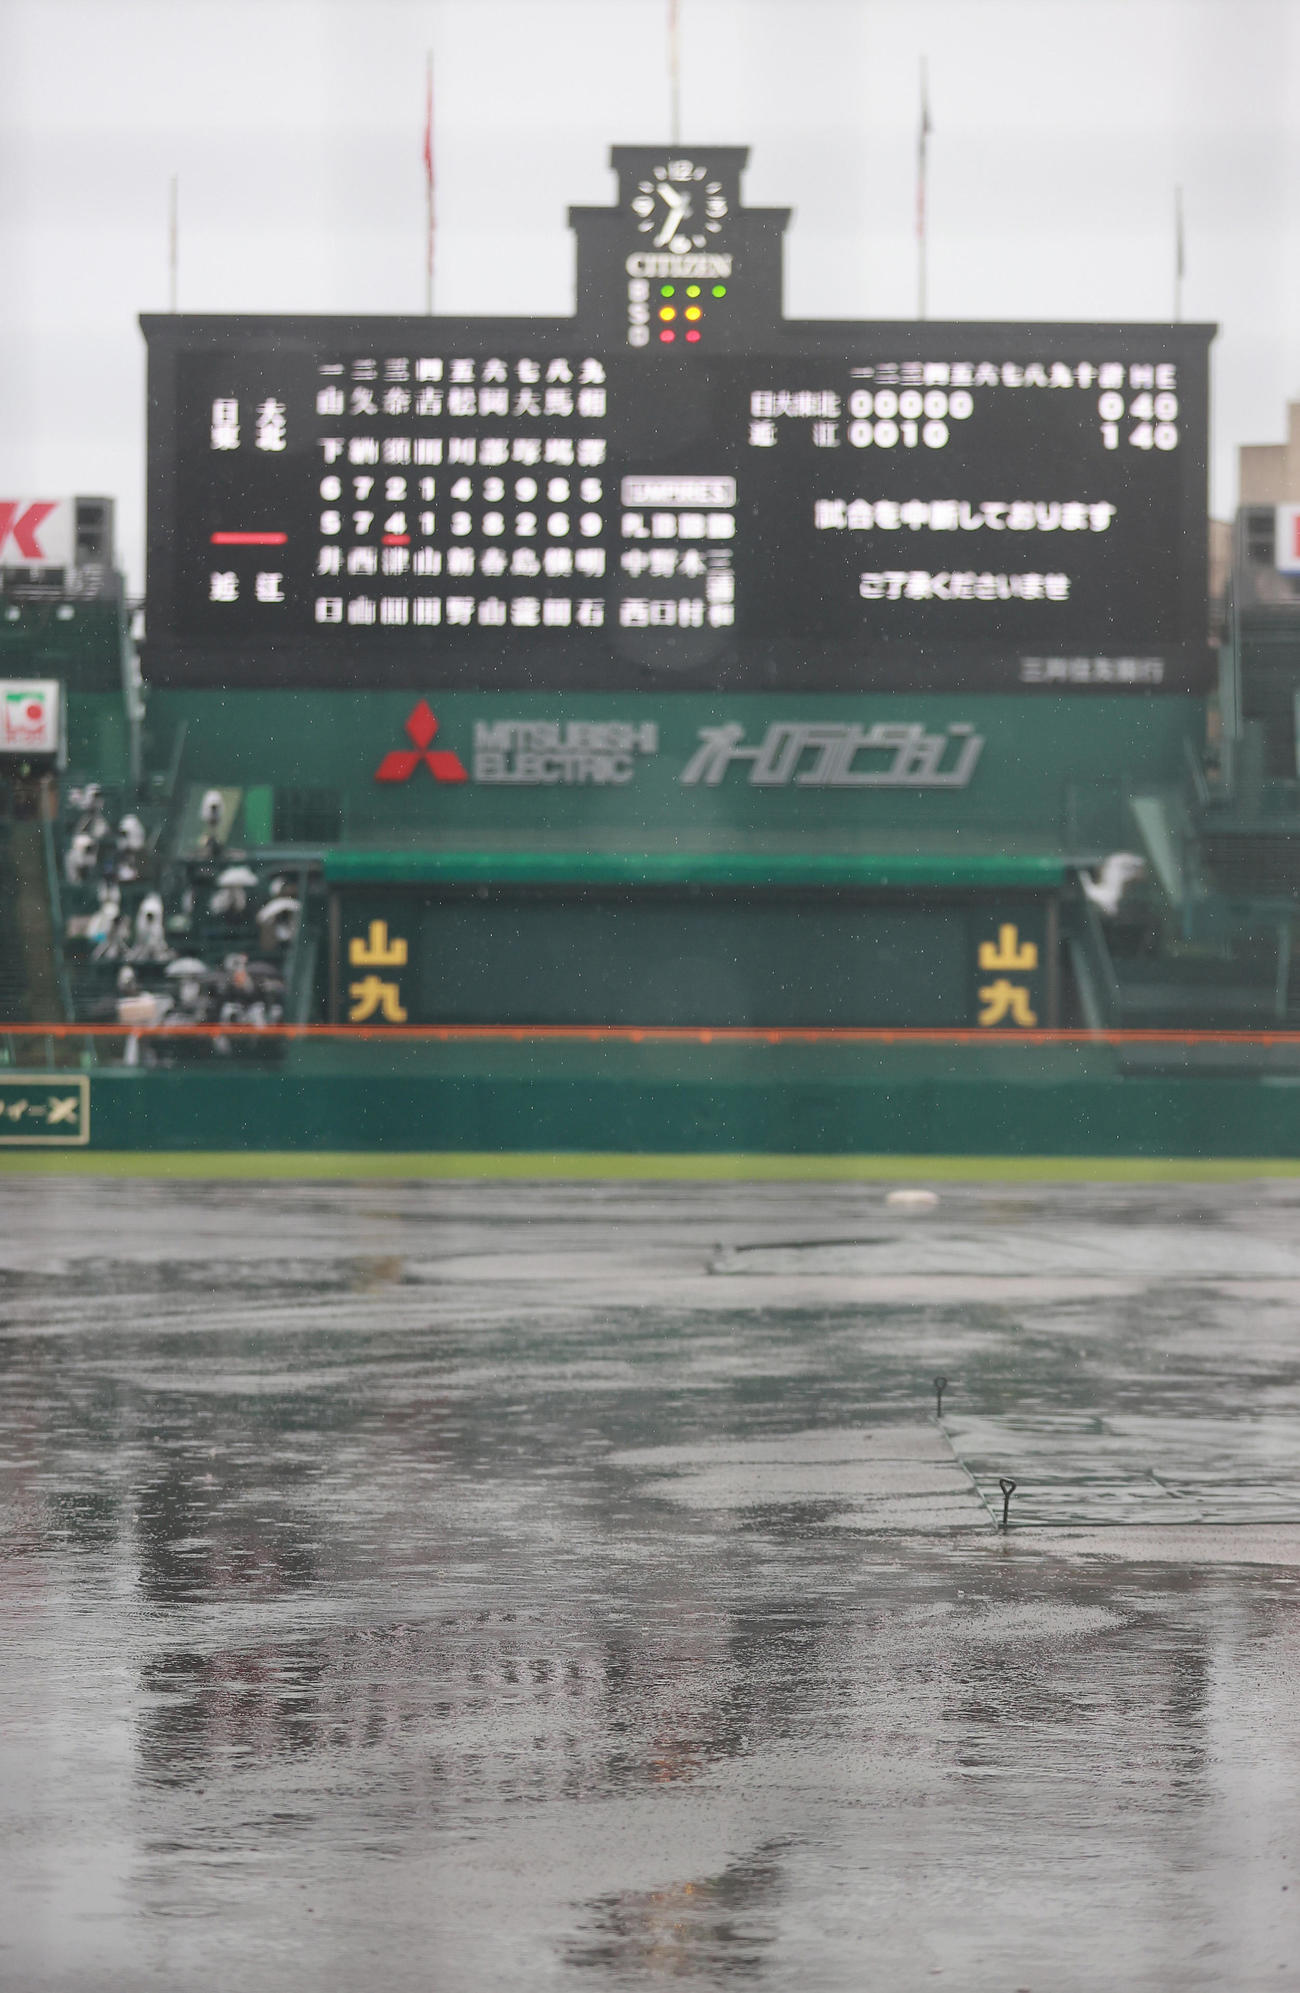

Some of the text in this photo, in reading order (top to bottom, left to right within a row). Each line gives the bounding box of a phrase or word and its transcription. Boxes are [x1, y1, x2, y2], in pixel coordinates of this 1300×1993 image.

[626, 252, 733, 278] CITIZEN
[475, 721, 657, 752] MITSUBISHI
[475, 753, 633, 783] ELECTRIC
[349, 920, 408, 1022] 山九
[979, 923, 1037, 1027] 山九
